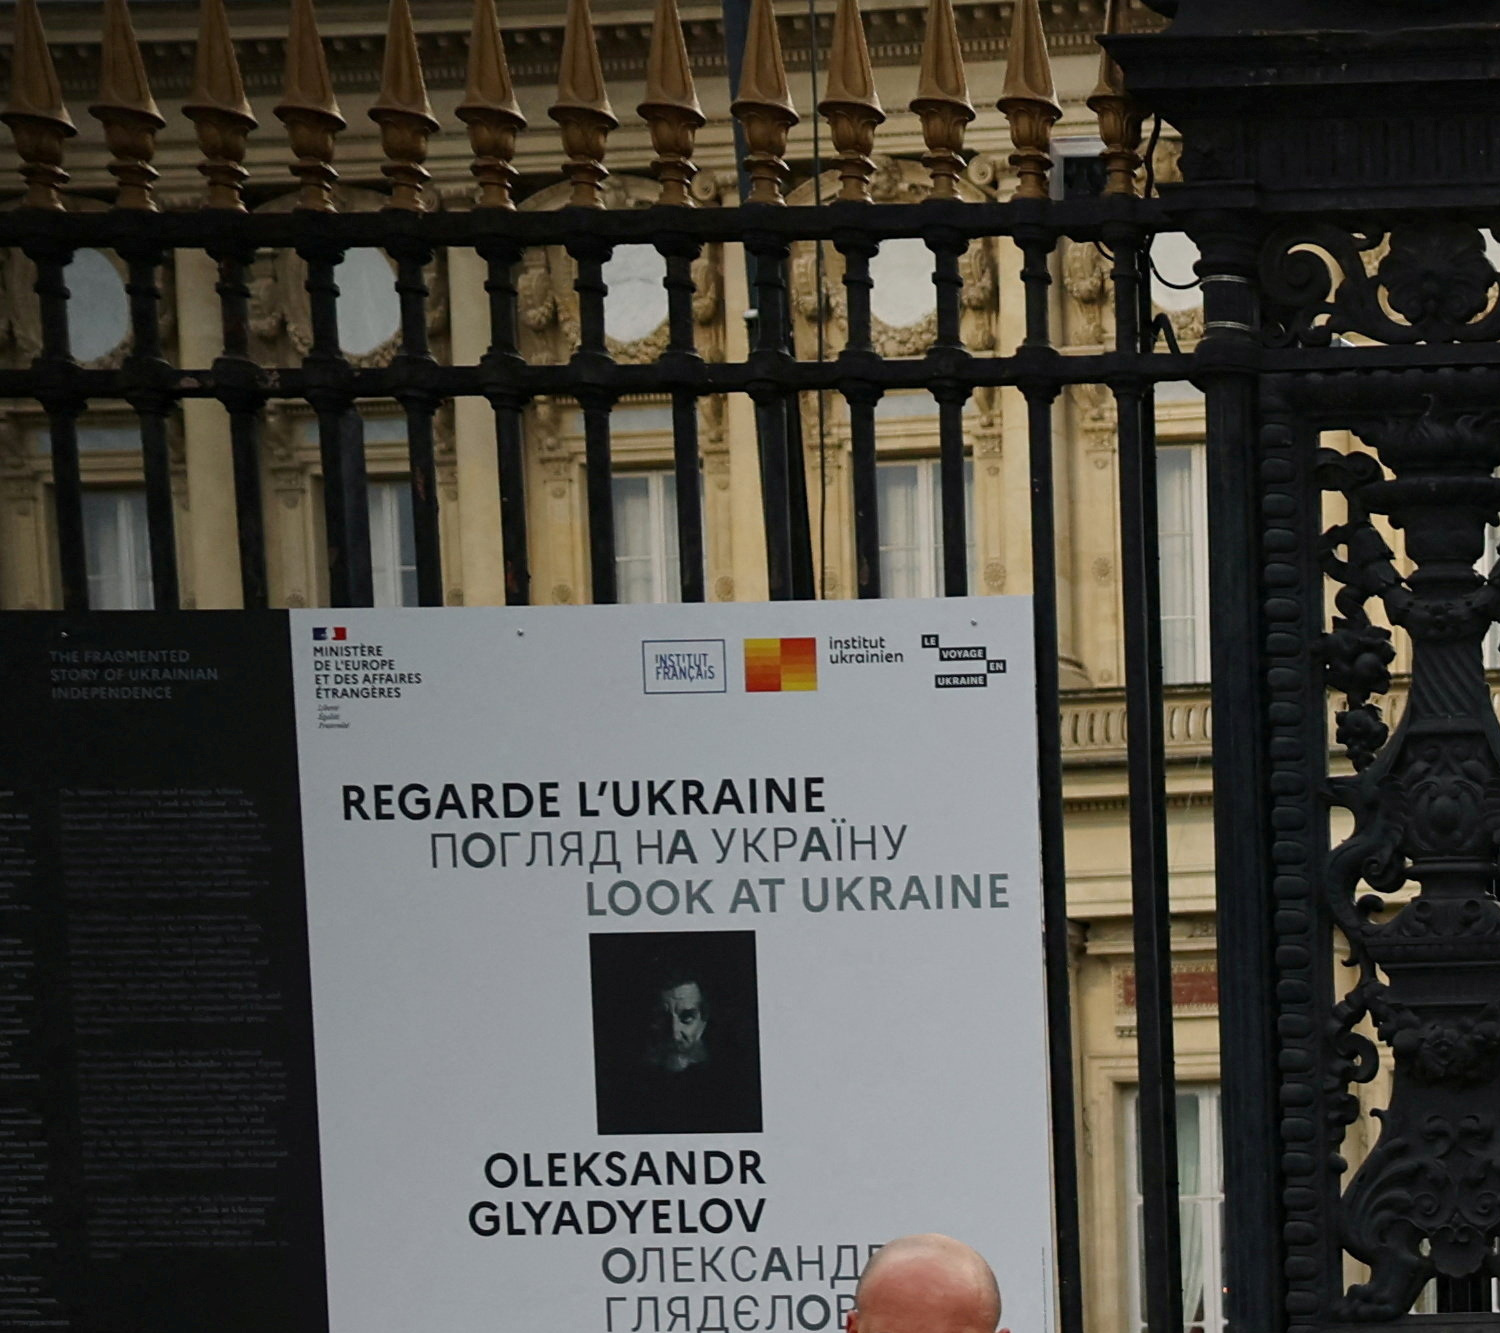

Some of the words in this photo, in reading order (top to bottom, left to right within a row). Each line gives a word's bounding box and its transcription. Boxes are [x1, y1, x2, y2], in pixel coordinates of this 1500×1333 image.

[829, 636, 886, 650] institut
[924, 636, 937, 646] LE
[84, 650, 190, 663] FRAGMENTED
[313, 643, 383, 657] MINISTÈRE
[942, 648, 984, 658] VOYAGE
[829, 650, 904, 664] ukrainien
[314, 660, 332, 671] DE
[335, 659, 395, 671] L'EUROPE
[989, 661, 1004, 671] EN
[128, 668, 218, 680] UKRAINIAN
[315, 673, 329, 685] ET
[334, 673, 359, 685] DES
[362, 672, 422, 685] AFFAIRES
[937, 675, 985, 686] UKRAINE
[52, 687, 173, 699] INDEPENDENCE
[315, 686, 402, 699] ÉTRANGÈRES
[342, 782, 563, 820] REGARDE
[430, 828, 620, 874] ПОГЛЯД
[636, 830, 698, 867] НА
[713, 819, 907, 868] УКРАЇНУ
[586, 880, 713, 917] LOOK
[728, 878, 787, 914] AT
[801, 873, 1010, 912] UKRAINE
[484, 1151, 766, 1189] OLEKSANDR
[468, 1198, 765, 1236] GLYADYELOV
